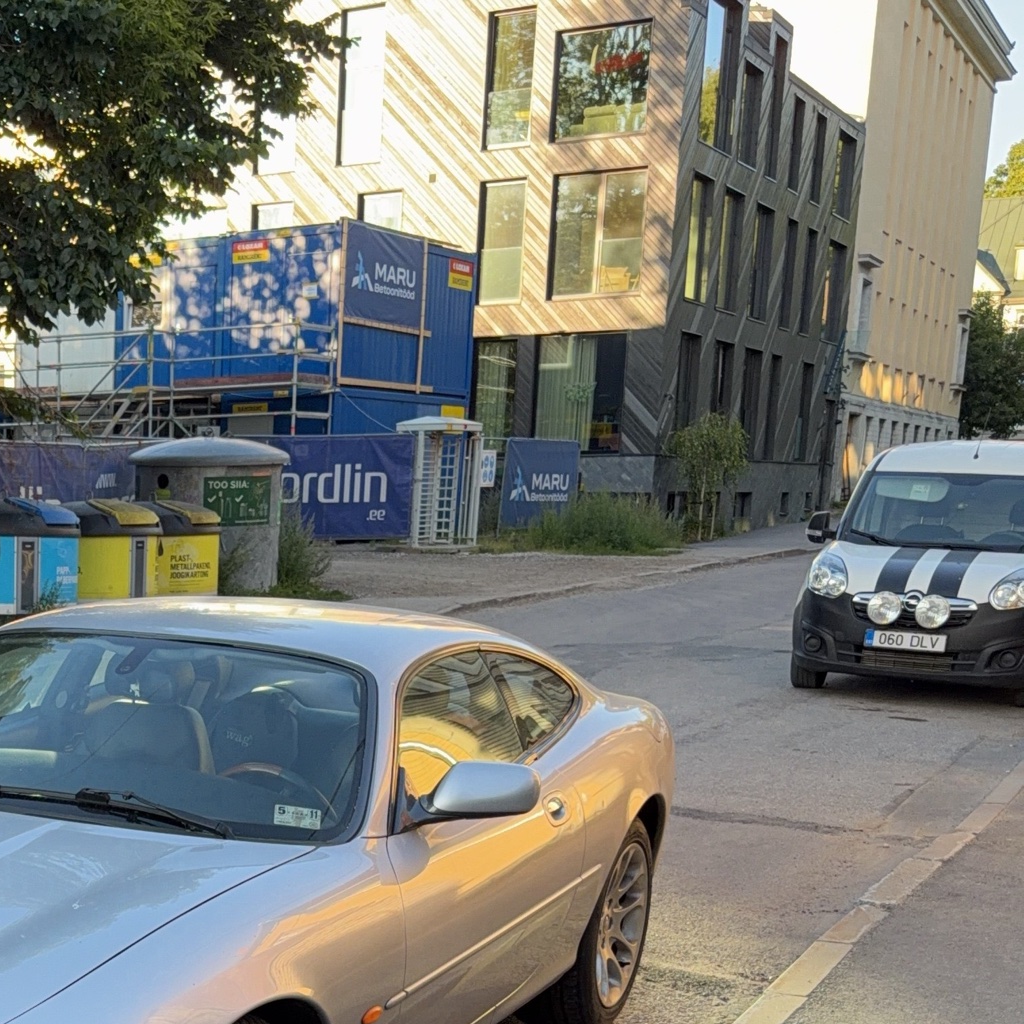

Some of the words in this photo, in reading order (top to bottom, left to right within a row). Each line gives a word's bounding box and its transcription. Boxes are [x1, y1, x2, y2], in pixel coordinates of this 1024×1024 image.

[375, 262, 416, 288] MARU
[208, 481, 228, 489] TOO
[230, 480, 250, 489] SIIA:
[281, 464, 387, 503] ordlin
[531, 473, 570, 491] MARU
[366, 509, 386, 521] .ee
[879, 632, 904, 646] 060
[909, 635, 939, 649] DLV
[278, 806, 286, 815] 5
[309, 810, 318, 820] 11
